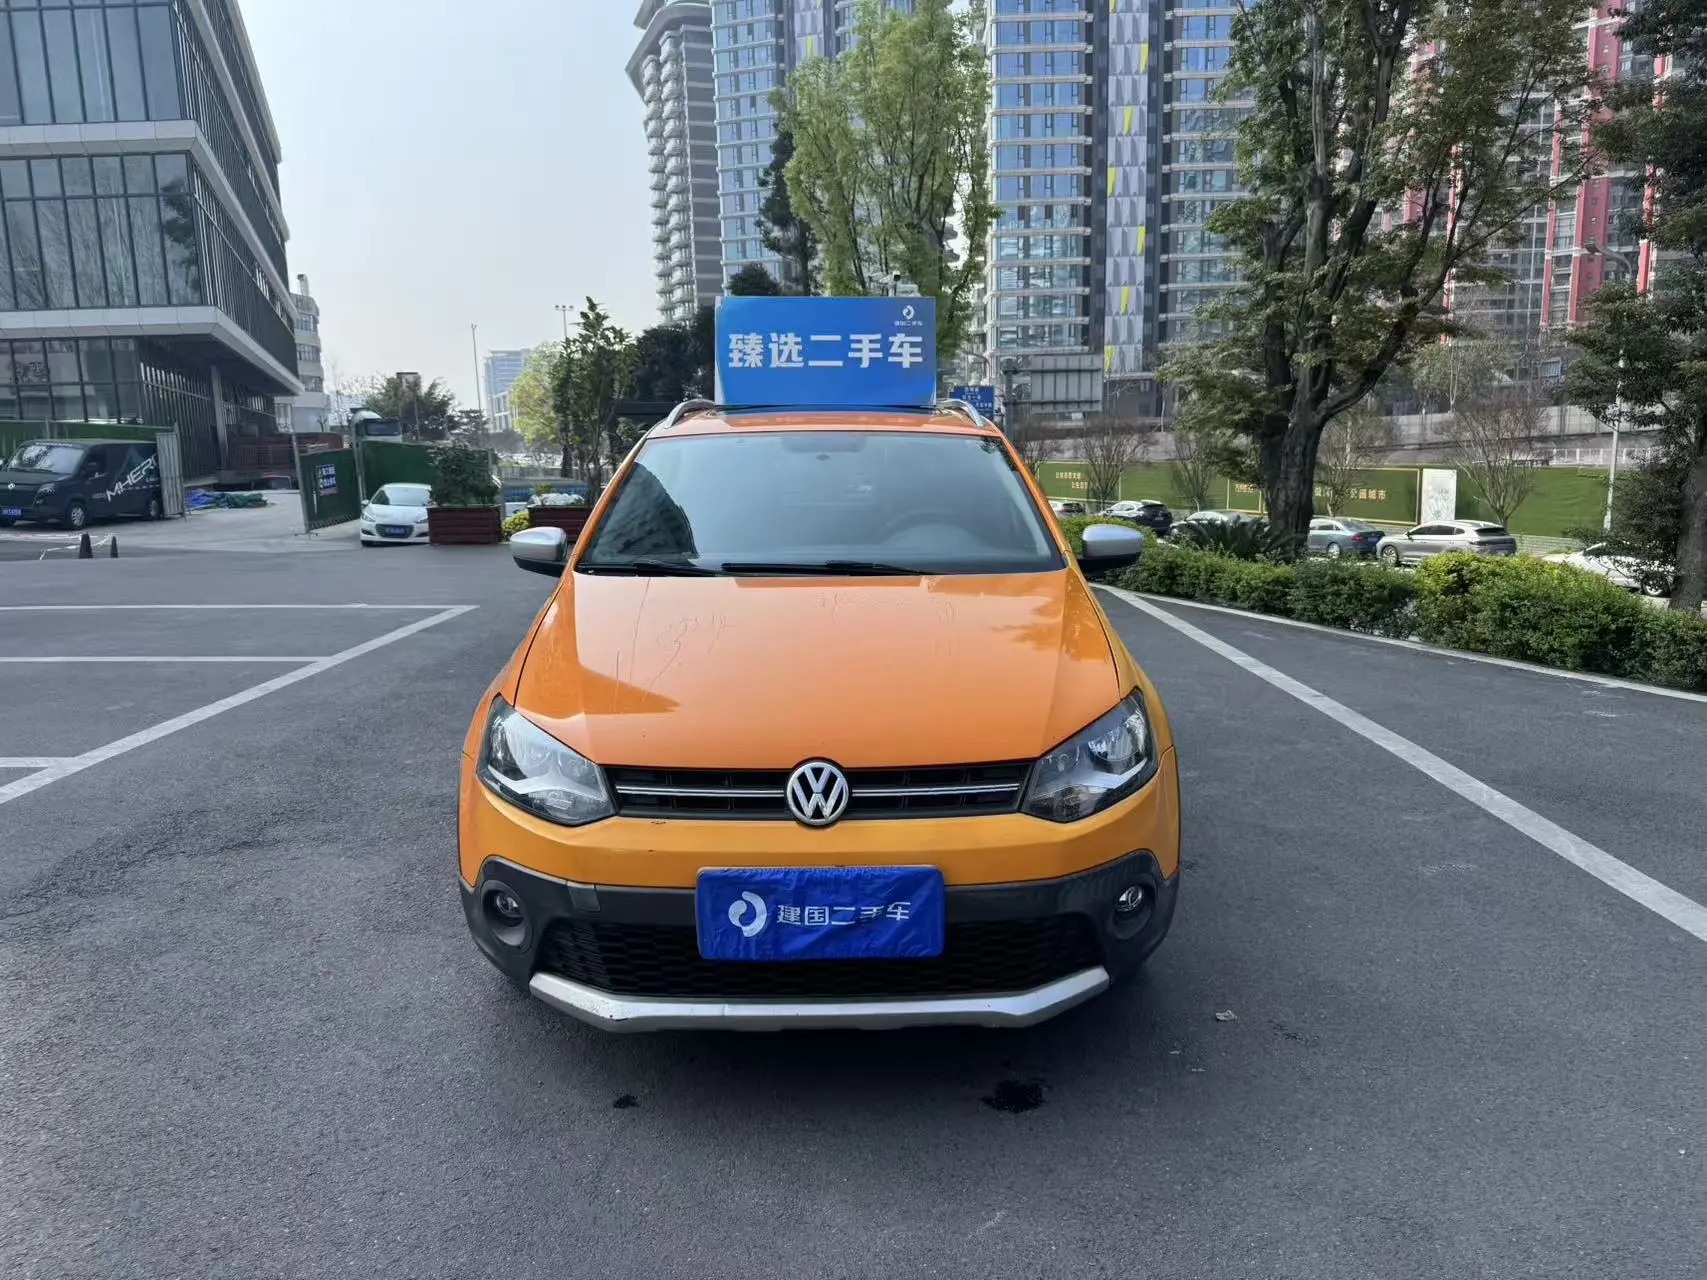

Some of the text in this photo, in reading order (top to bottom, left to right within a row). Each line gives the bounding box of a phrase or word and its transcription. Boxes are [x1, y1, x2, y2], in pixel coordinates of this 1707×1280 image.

[728, 332, 923, 369] 臻选二手车
[788, 762, 848, 823] VW
[777, 901, 911, 926] 建国二手车
